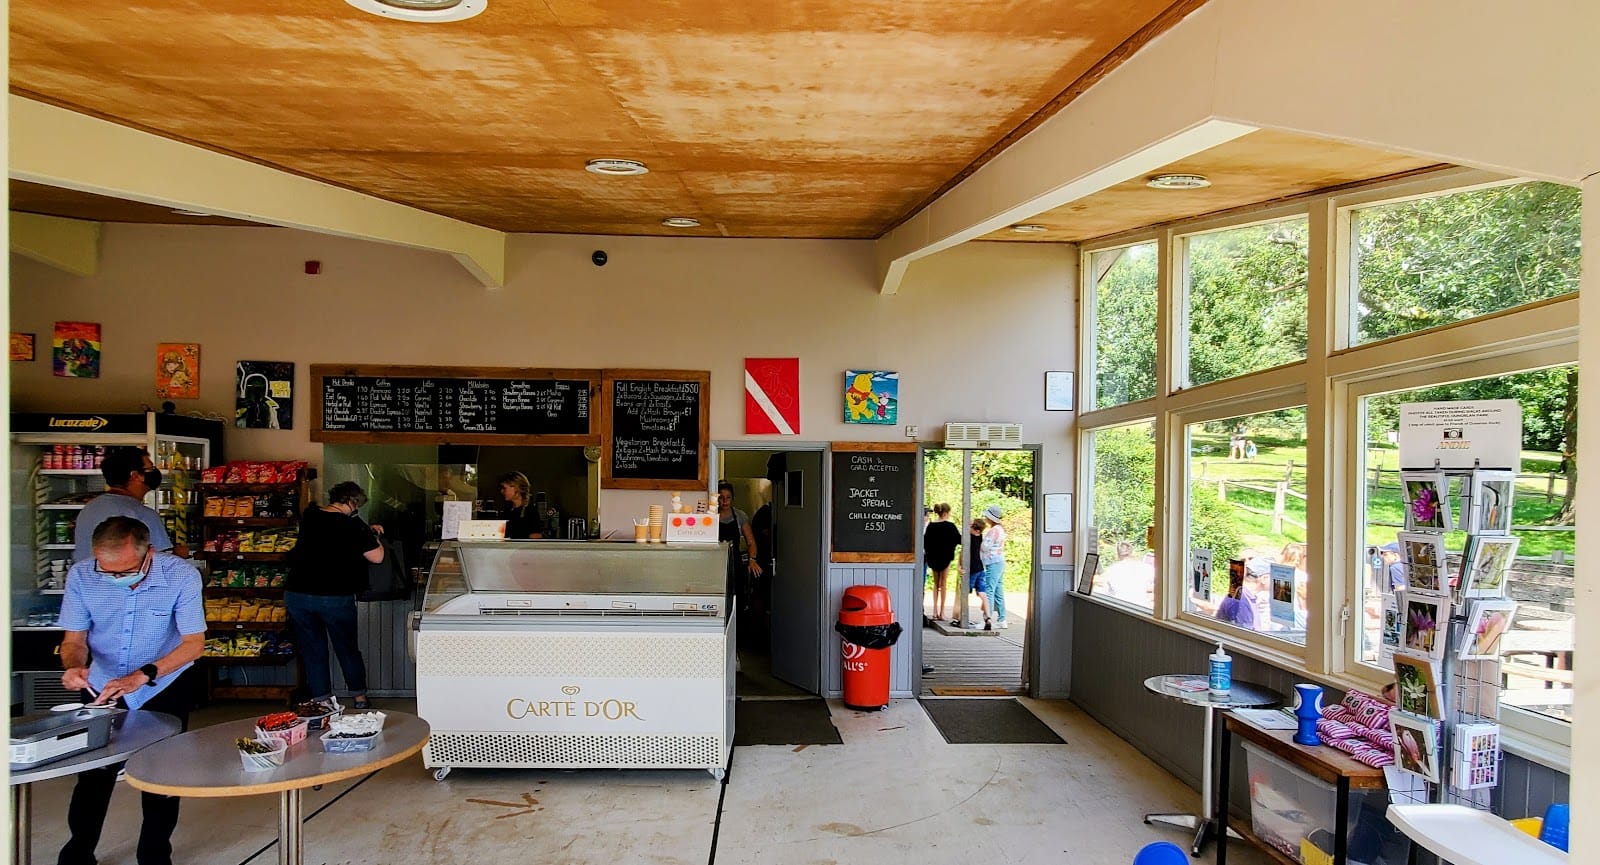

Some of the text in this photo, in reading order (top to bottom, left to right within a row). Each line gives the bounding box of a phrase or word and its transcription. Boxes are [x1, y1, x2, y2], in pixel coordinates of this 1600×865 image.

[616, 382, 628, 392] Full
[630, 383, 651, 394] English
[654, 383, 681, 392] Breakfast
[616, 436, 649, 447] Vegetarian
[653, 437, 680, 446] Breakfast
[851, 456, 872, 464] CASH
[849, 488, 879, 498] JACKET
[507, 698, 646, 721] CARTE D'OR
